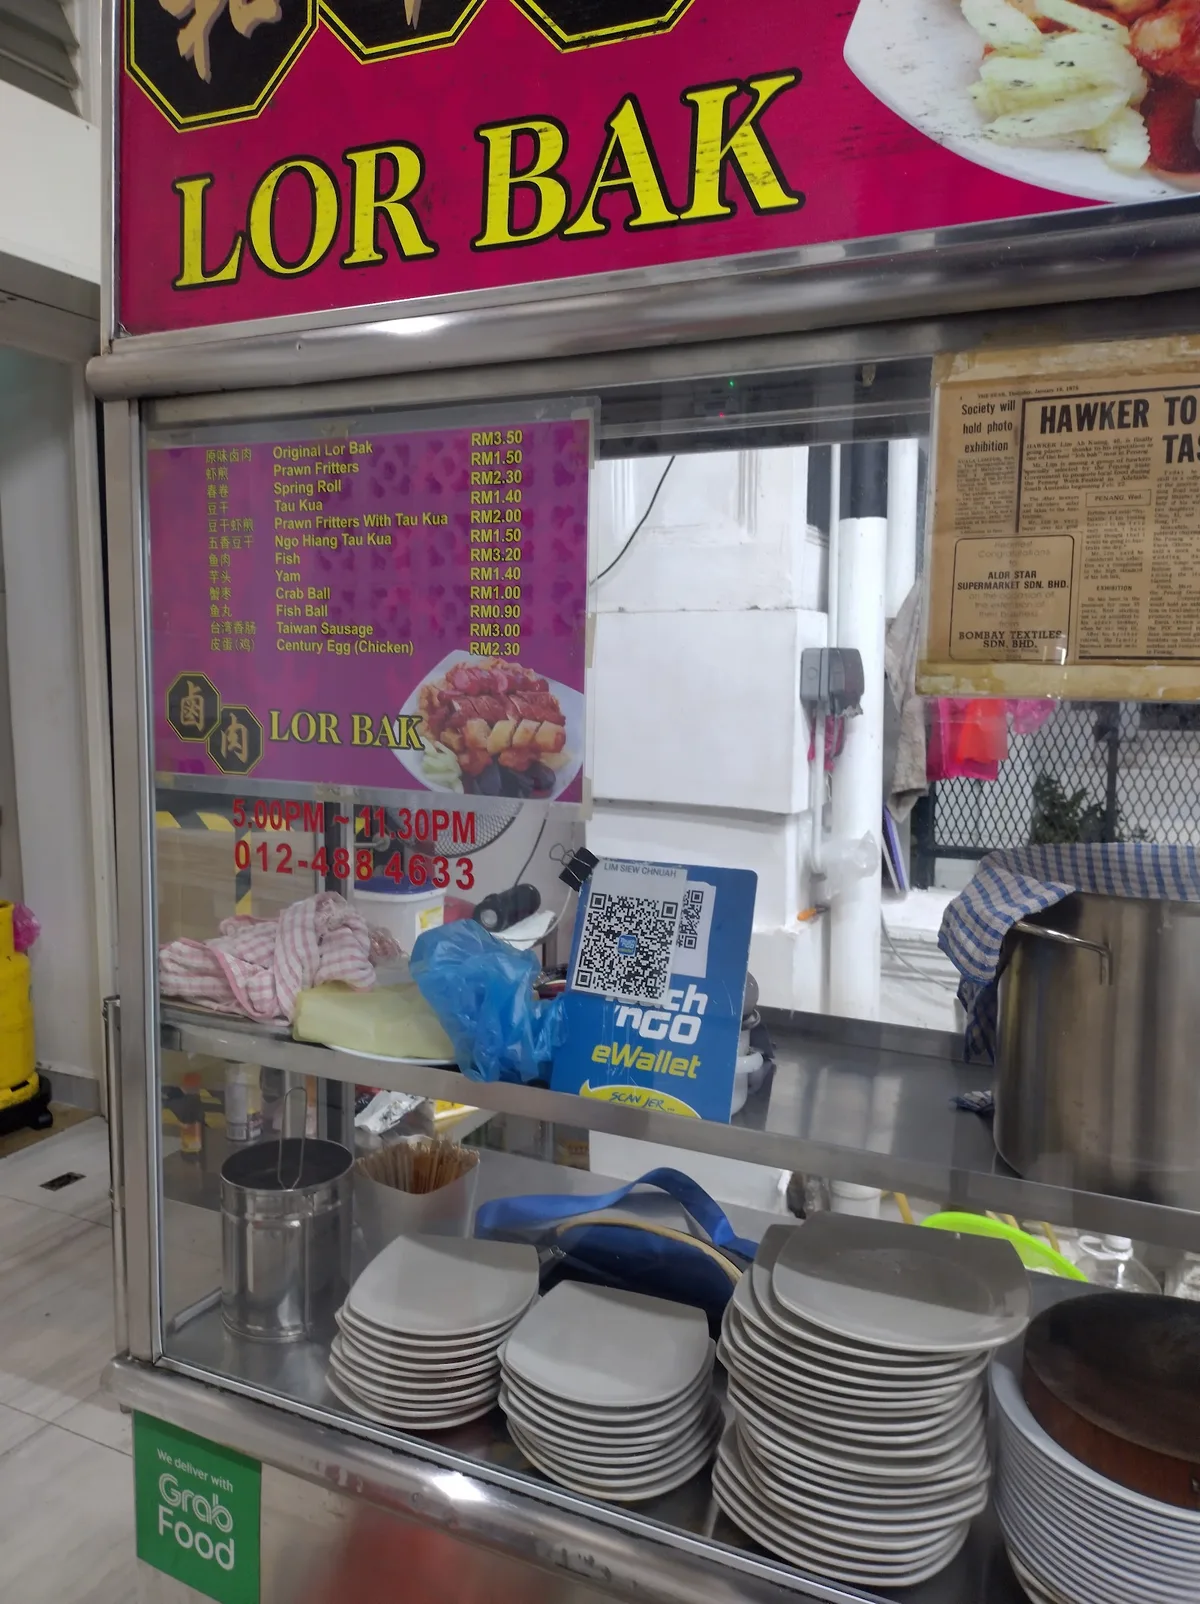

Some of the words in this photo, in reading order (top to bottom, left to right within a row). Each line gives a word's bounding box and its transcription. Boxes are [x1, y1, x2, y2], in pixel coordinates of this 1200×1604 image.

[172, 141, 438, 291] LOR
[470, 68, 806, 252] BAK
[962, 402, 996, 415] Society
[1000, 400, 1016, 412] will
[1040, 399, 1149, 434] HAWKER
[1164, 395, 1197, 426] TO
[963, 423, 982, 434] hold
[987, 421, 1013, 434] photo
[471, 430, 523, 447] RM3.50
[273, 444, 320, 461] Original
[324, 442, 345, 455] Lor
[349, 441, 373, 454] Bak
[964, 441, 1009, 454] exhibition
[1162, 433, 1200, 465] TA
[206, 448, 252, 464] 原味卤肉
[471, 450, 523, 466] RM1.50
[273, 464, 311, 477] Prawn
[315, 461, 359, 474] Fritters
[470, 469, 522, 485] RM2.30
[207, 484, 229, 499] 春卷
[274, 481, 314, 496] Spring
[317, 479, 342, 492] Roll
[470, 489, 522, 504] RM1.40
[207, 501, 229, 516] 豆干
[275, 499, 295, 512] Tau
[300, 499, 323, 511] Kua
[274, 516, 312, 529] Prawn
[315, 515, 360, 528] Fritters
[363, 514, 391, 527] With
[396, 512, 418, 526] Tau
[422, 512, 448, 524] Kua
[470, 508, 522, 523] RM2.00
[208, 517, 254, 533] 豆干虾煎
[208, 535, 253, 549] 五香豆干
[275, 534, 299, 549] Ngo
[303, 533, 337, 549] Hiang
[341, 532, 363, 546] Tau
[367, 532, 392, 545] Kua
[470, 528, 522, 543] RM1.50
[208, 553, 231, 567] 鱼肉
[275, 551, 300, 564] Fish
[470, 547, 521, 562] RM3.20
[209, 569, 231, 584] 芋头
[275, 570, 300, 582] Yam
[470, 566, 521, 581] RM1.40
[988, 571, 1010, 580] ALOR
[1014, 570, 1037, 579] STAR
[470, 585, 521, 600] RM1.00
[957, 581, 1020, 591] SUPERMARKET
[1024, 580, 1044, 589] SDN.
[1048, 580, 1069, 589] BHD.
[276, 587, 304, 600] Crab
[307, 587, 330, 600] Ball
[210, 603, 232, 618] 鱼丸
[276, 604, 301, 617] Fish
[305, 604, 328, 617] Ball
[470, 604, 521, 619] RM0.90
[210, 620, 256, 635] 台湾香肠
[276, 622, 317, 635] Taiwan
[321, 622, 374, 638] Sausage
[470, 623, 521, 637] RM3.00
[959, 631, 1005, 640] BOMBAY
[1009, 630, 1063, 640] TEXTILES
[276, 639, 325, 654] Century
[327, 639, 350, 655] Egg
[355, 640, 414, 656] (Chicken)
[469, 641, 520, 656] RM2.30
[983, 640, 1009, 648] SDN.
[1012, 640, 1038, 648] BHD.
[269, 709, 342, 744] LOR
[351, 714, 425, 751] BAK
[220, 713, 249, 763] 肉
[233, 799, 324, 833] 5.00PM
[359, 806, 476, 844] 11.30PM
[234, 840, 374, 881] 012-488
[385, 855, 475, 891] 4633
[604, 862, 618, 871] LIM
[620, 864, 639, 874] SIEW
[641, 866, 677, 878] CHNUAH
[591, 1042, 702, 1079] eWallet
[610, 1091, 642, 1104] SCAN
[157, 1448, 172, 1465] We
[174, 1457, 208, 1481] deliver
[211, 1474, 234, 1493] with
[158, 1472, 234, 1533] Grab
[158, 1504, 235, 1571] Food
